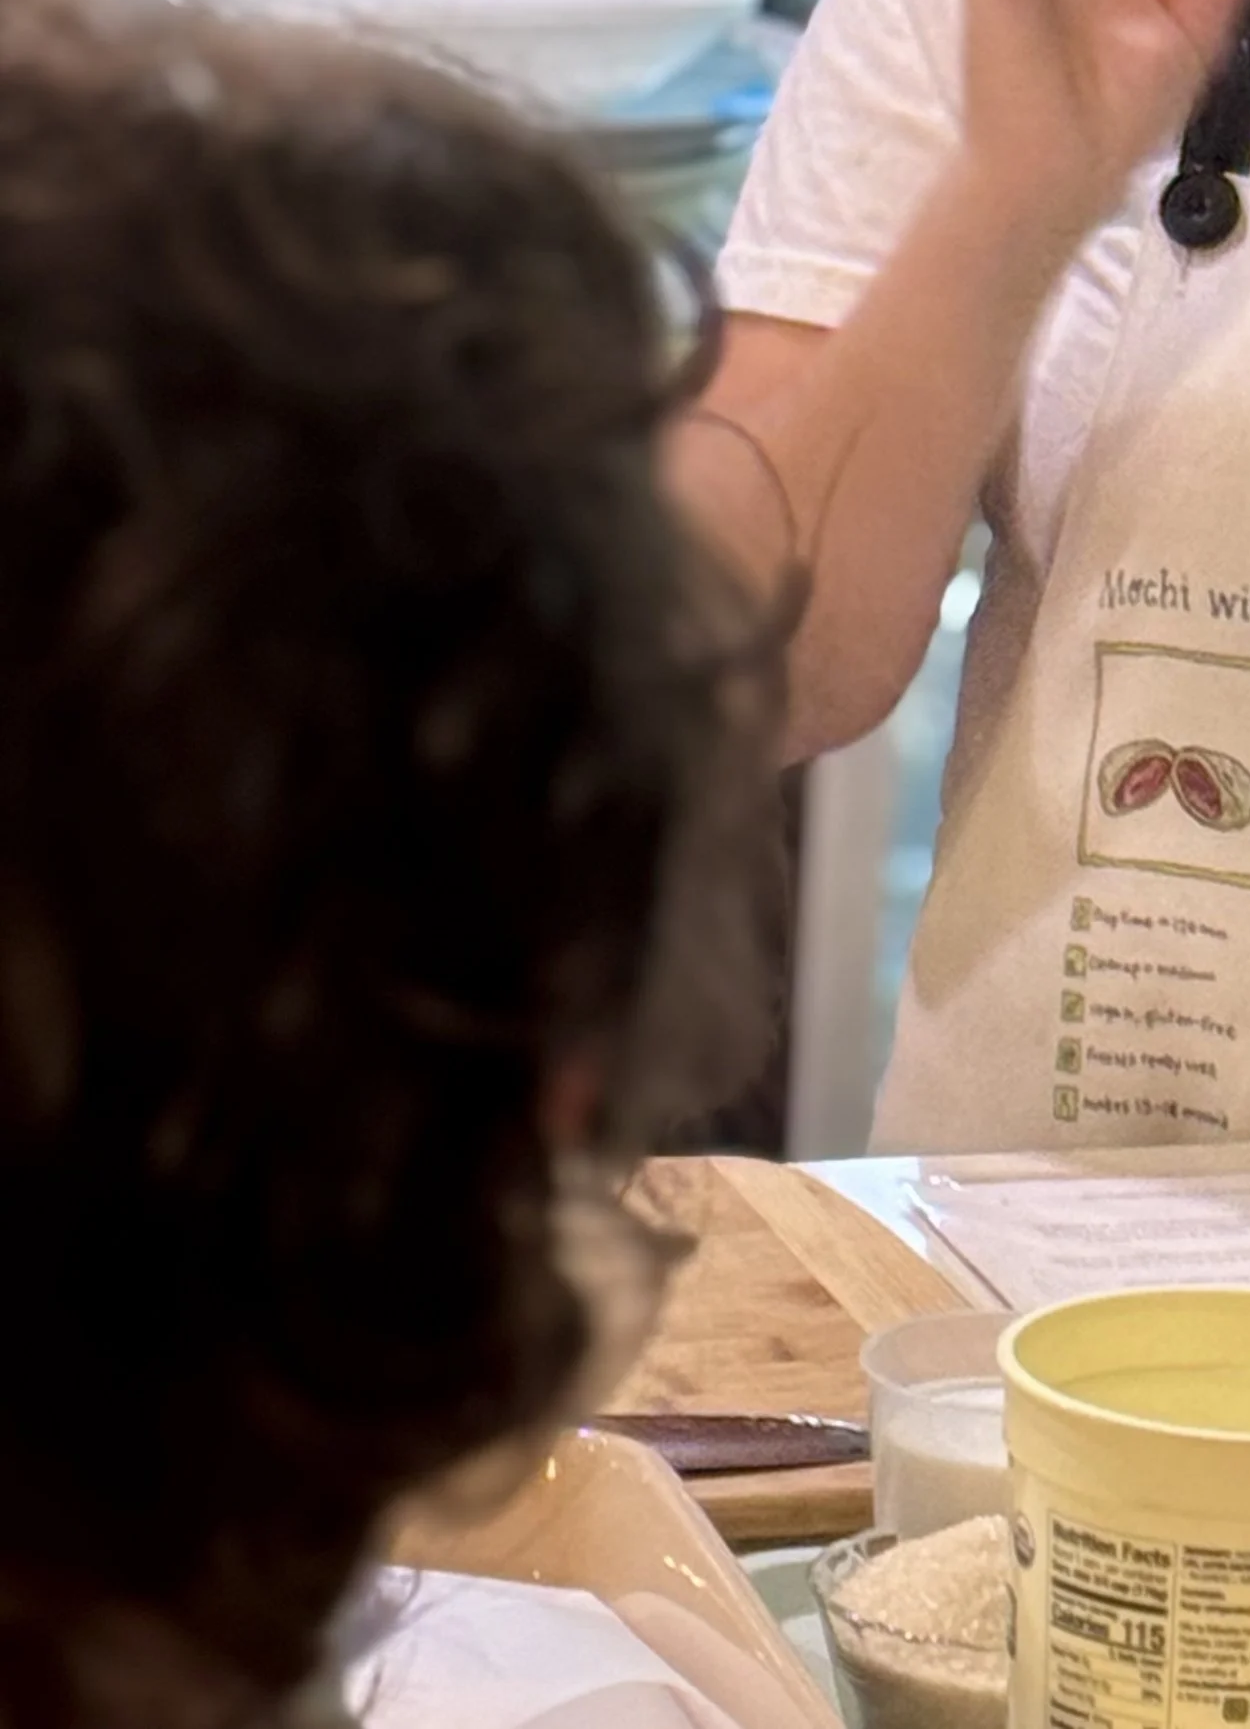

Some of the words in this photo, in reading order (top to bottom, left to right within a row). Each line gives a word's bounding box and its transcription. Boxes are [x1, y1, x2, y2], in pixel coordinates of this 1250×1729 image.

[1099, 569, 1191, 611] Mochi
[1052, 1519, 1118, 1558] Nutrition
[1121, 1540, 1171, 1568] Facts
[1051, 1600, 1110, 1640] Calories
[1121, 1619, 1166, 1654] 115
